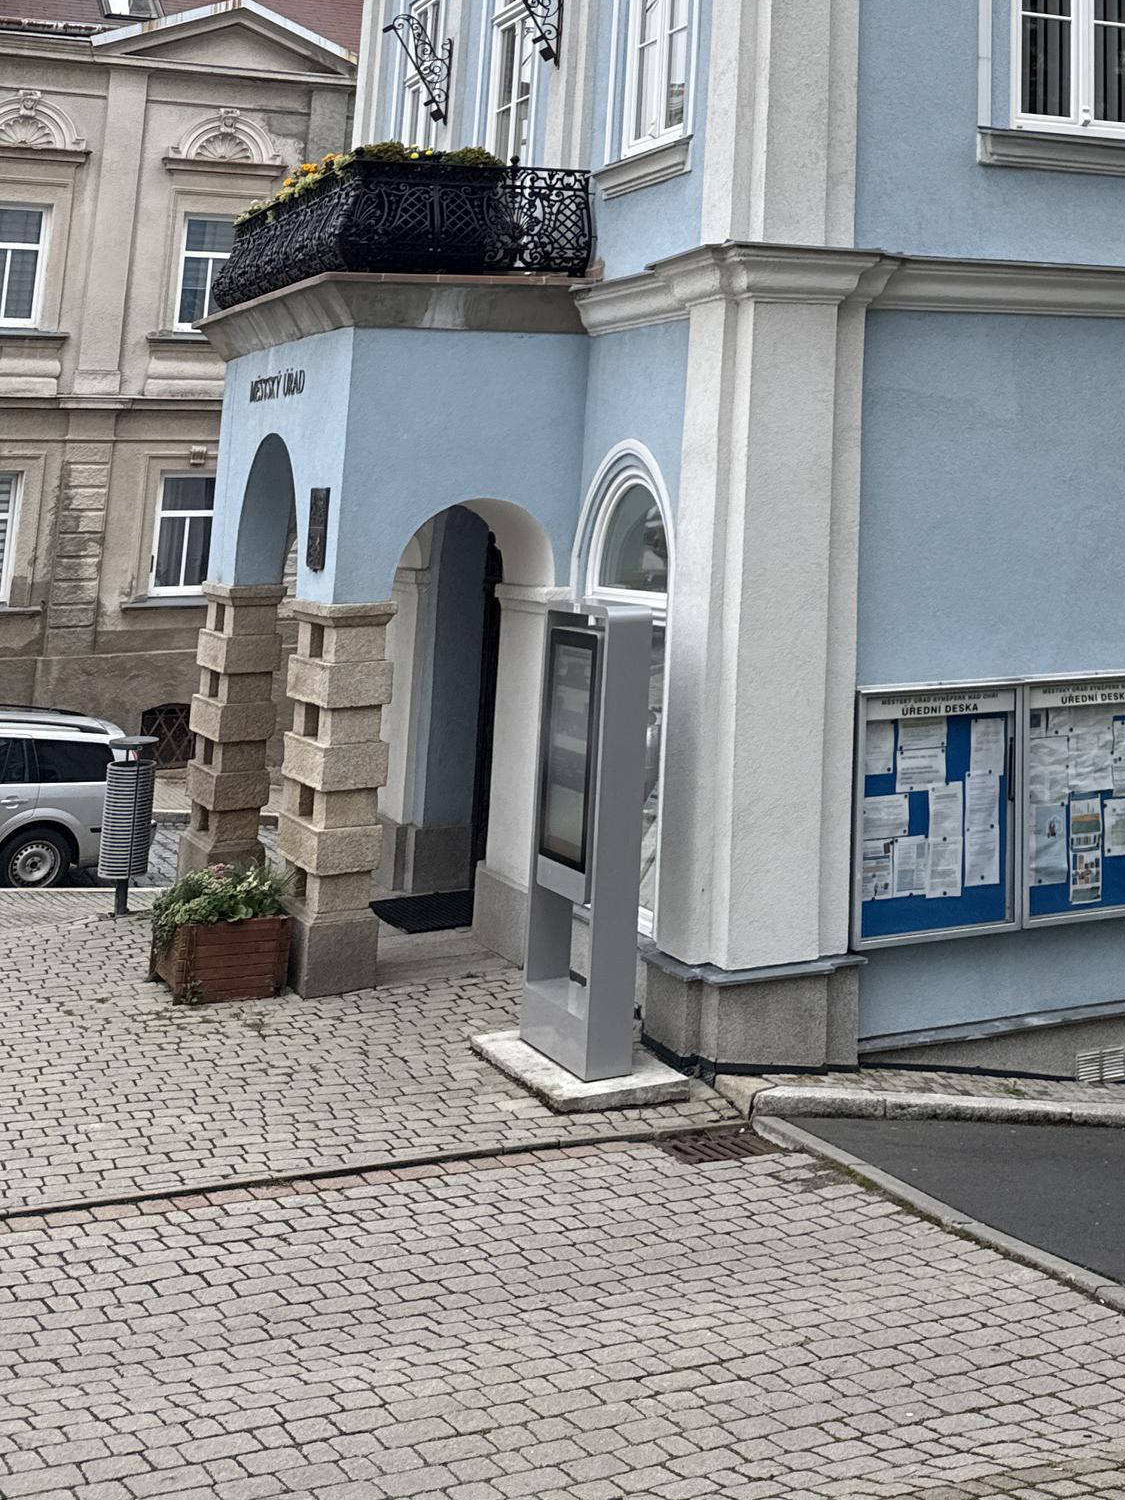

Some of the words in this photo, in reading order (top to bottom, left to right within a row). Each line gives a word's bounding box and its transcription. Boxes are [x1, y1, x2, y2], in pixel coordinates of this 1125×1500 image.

[1061, 692, 1098, 704] ÚŘEDNÍ
[902, 703, 941, 716] ÚŘEDNÍ
[945, 703, 978, 713] DESKA
